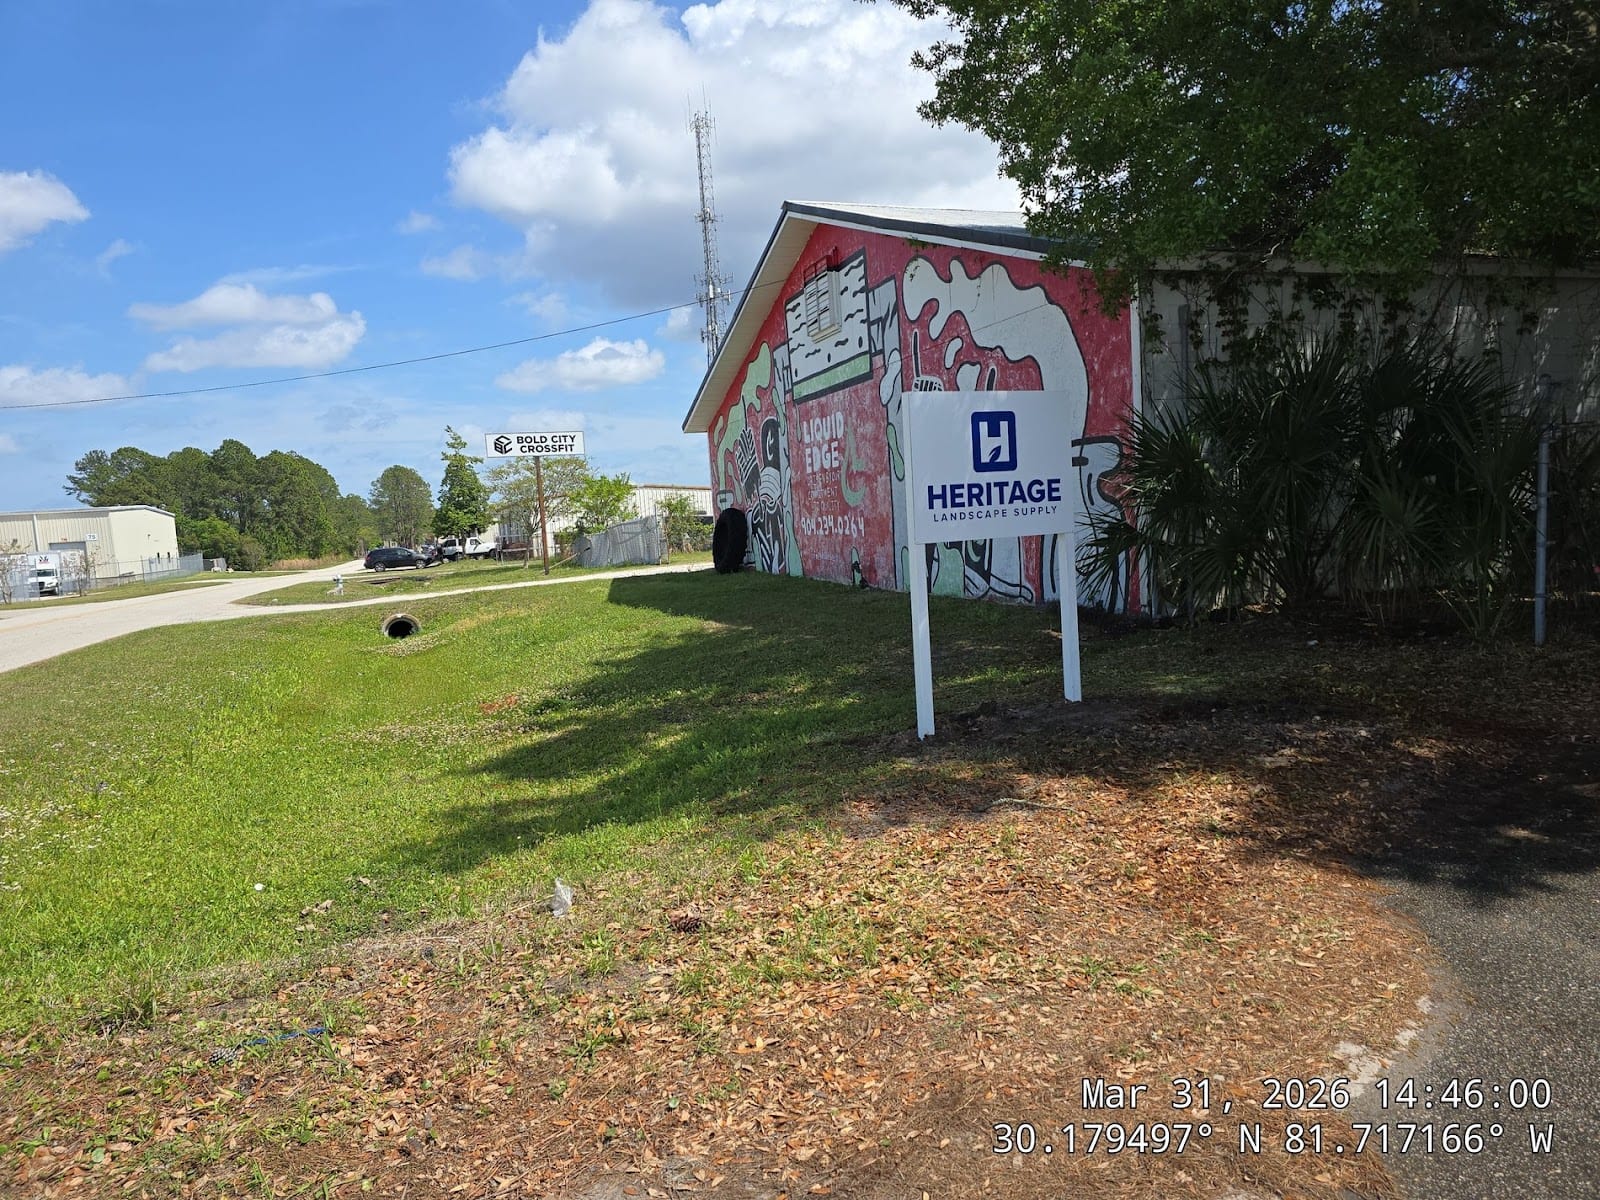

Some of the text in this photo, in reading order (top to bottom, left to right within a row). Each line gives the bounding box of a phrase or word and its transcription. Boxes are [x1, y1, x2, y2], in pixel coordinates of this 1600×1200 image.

[516, 434, 576, 444] BOLD CITY
[803, 411, 845, 444] LIQUID
[520, 444, 575, 453] CROSSFIT
[805, 441, 840, 473] EDGE
[927, 478, 1062, 510] HERITAGE
[933, 505, 1058, 522] LANDSCAPE SUPPLY
